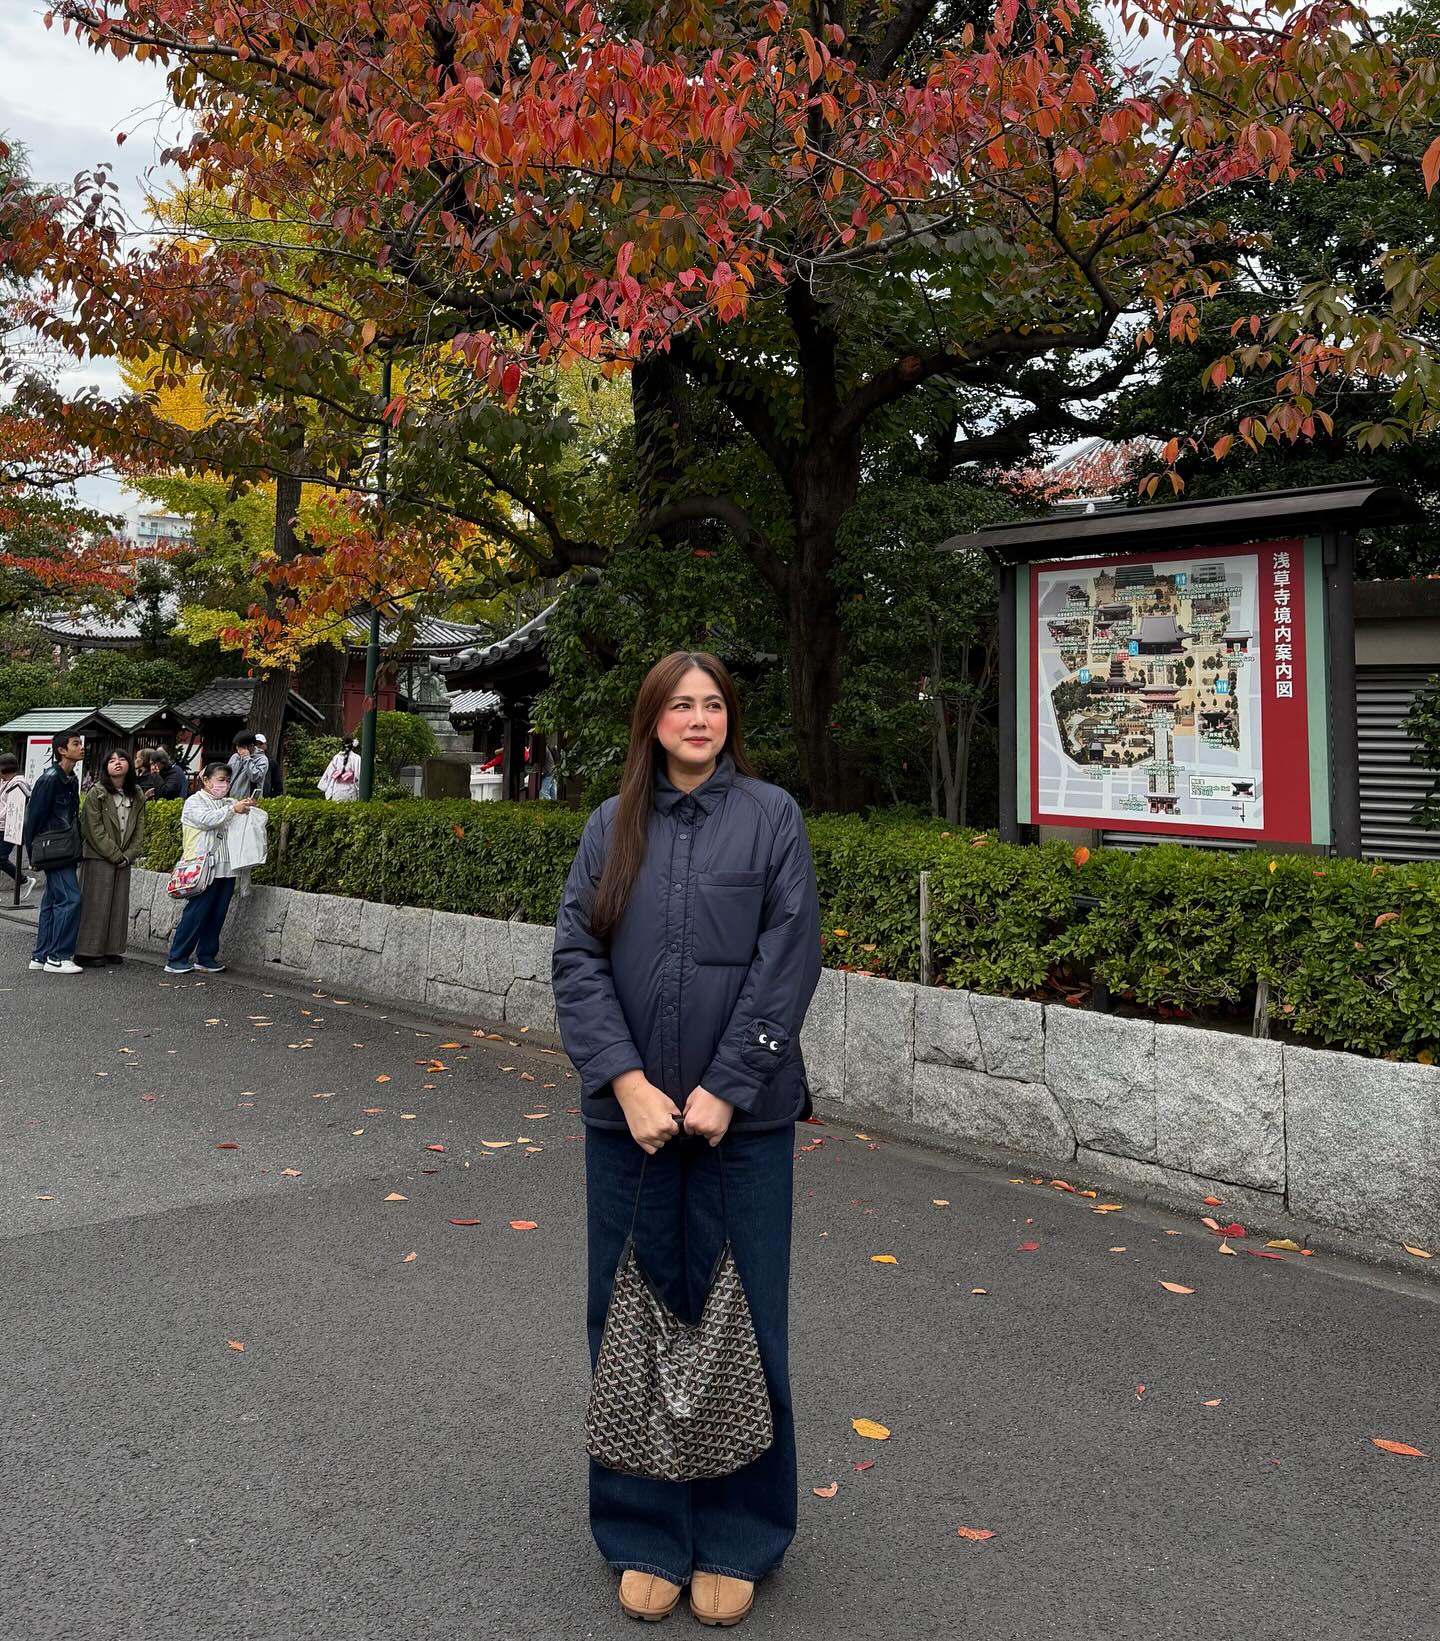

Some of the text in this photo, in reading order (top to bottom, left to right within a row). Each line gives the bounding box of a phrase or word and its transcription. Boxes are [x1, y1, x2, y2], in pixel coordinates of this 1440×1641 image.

[1273, 552, 1293, 698] 浅草寺境内案内図
